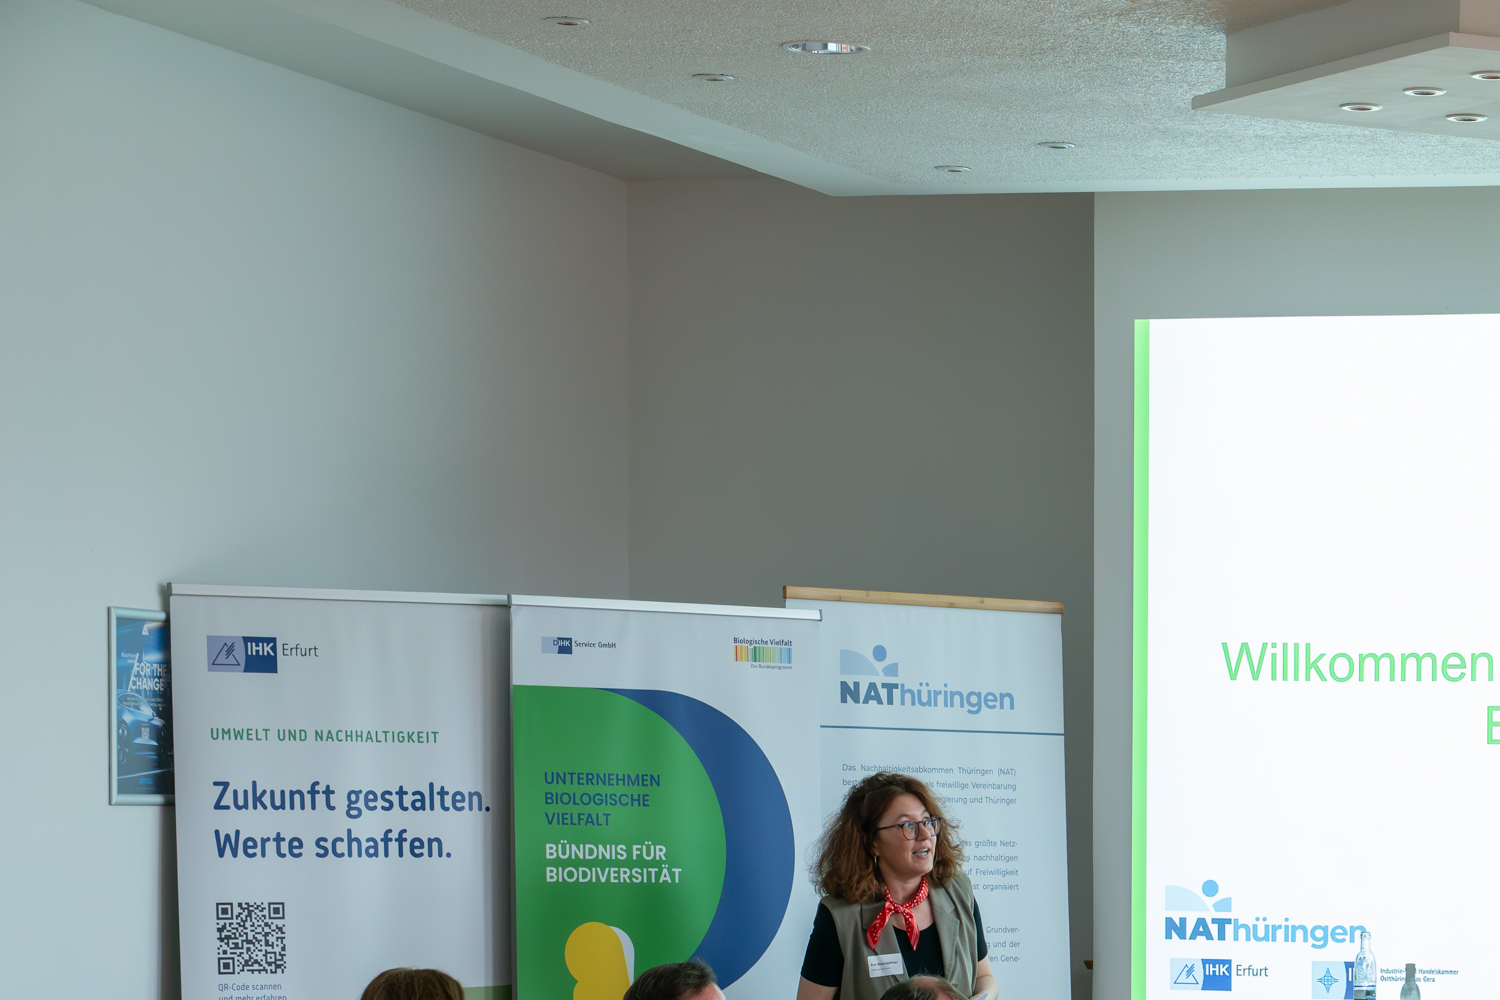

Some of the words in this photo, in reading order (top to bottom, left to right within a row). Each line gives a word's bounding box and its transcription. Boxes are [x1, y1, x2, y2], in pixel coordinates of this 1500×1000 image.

[552, 639, 571, 648] DIHK
[574, 640, 596, 648] Service
[598, 641, 617, 650] GmbH
[733, 636, 769, 646] Biologische
[770, 638, 793, 647] Vielfalt
[248, 642, 275, 656] IHK
[282, 643, 319, 658] Erfurt
[1221, 642, 1494, 683] Willkommen
[130, 677, 166, 692] CHANGE
[840, 680, 1015, 715] NAThüringen
[210, 728, 271, 742] UMWELT
[277, 728, 308, 742] UND
[314, 729, 440, 744] NACHHALTIGKEIT
[842, 764, 857, 772] Das
[860, 764, 954, 774] Nachhaltigkeitsabkommen
[958, 766, 994, 777] Thüringen
[997, 768, 1017, 777] (NAT)
[544, 771, 661, 788] UNTERNEHMEN
[936, 780, 970, 791] freiwillige
[971, 781, 1017, 792] Vereinbarung
[212, 780, 336, 812] Zukunft
[345, 782, 491, 820] gestalten.
[544, 792, 650, 808] BIOLOGISCHE
[969, 796, 983, 804] und
[984, 796, 1017, 806] Thüringer
[544, 812, 612, 826] VIELFALT
[214, 828, 304, 859] Werte
[314, 828, 452, 859] schaffen.
[545, 840, 628, 860] BÜNDNIS
[632, 841, 667, 860] FÜR
[974, 840, 998, 848] größte
[1000, 840, 1018, 848] Netz-
[974, 854, 1019, 863] nachhaltigen
[546, 864, 683, 884] BIODIVERSITÄT
[976, 868, 1019, 878] Freiwilligkeit
[982, 883, 1020, 892] organisiert
[986, 926, 1021, 934] Grundver-
[1165, 916, 1366, 950] NAThüringen
[992, 940, 1006, 948] und
[1008, 940, 1021, 948] der
[1000, 954, 1021, 962] Gene-
[1205, 963, 1230, 976] IHK
[1236, 964, 1269, 978] Erfurt
[218, 982, 250, 992] QR-Code
